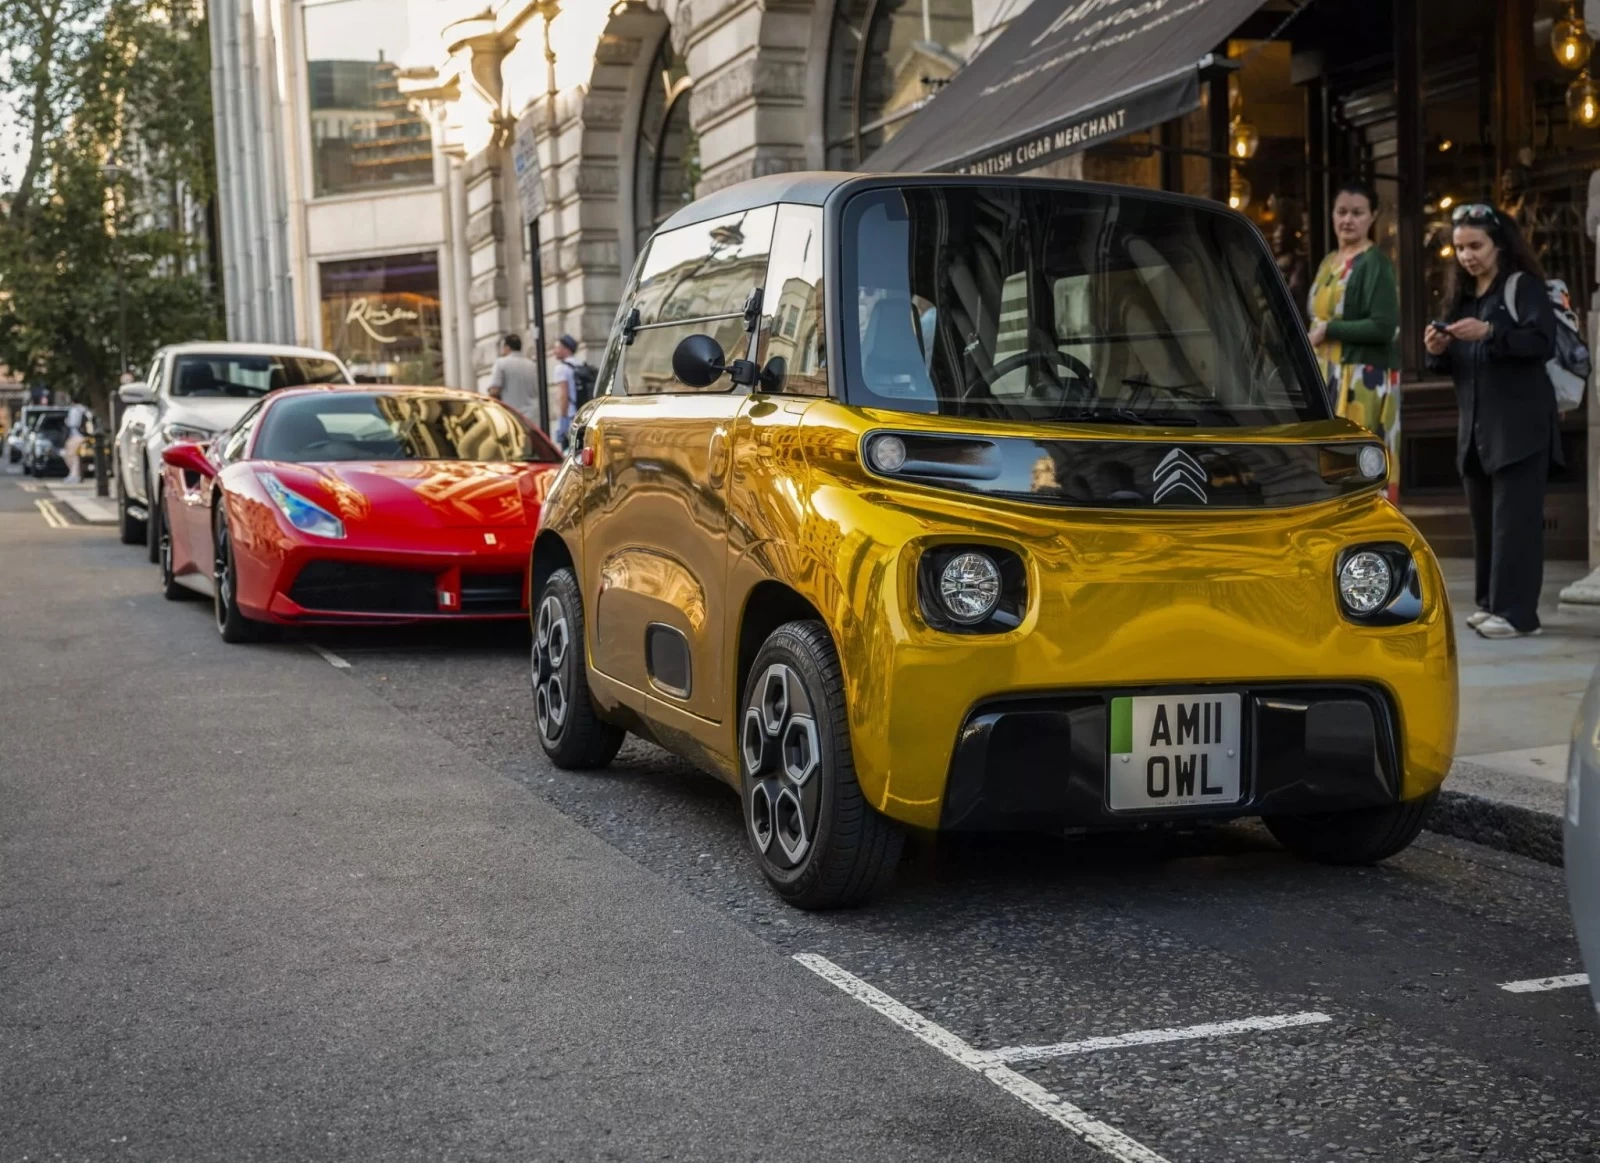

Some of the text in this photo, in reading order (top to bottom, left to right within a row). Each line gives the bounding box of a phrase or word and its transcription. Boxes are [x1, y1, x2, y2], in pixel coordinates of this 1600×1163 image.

[969, 109, 1126, 174] BRITISH CIGAR MERCHANT
[1147, 754, 1223, 798] OWL
